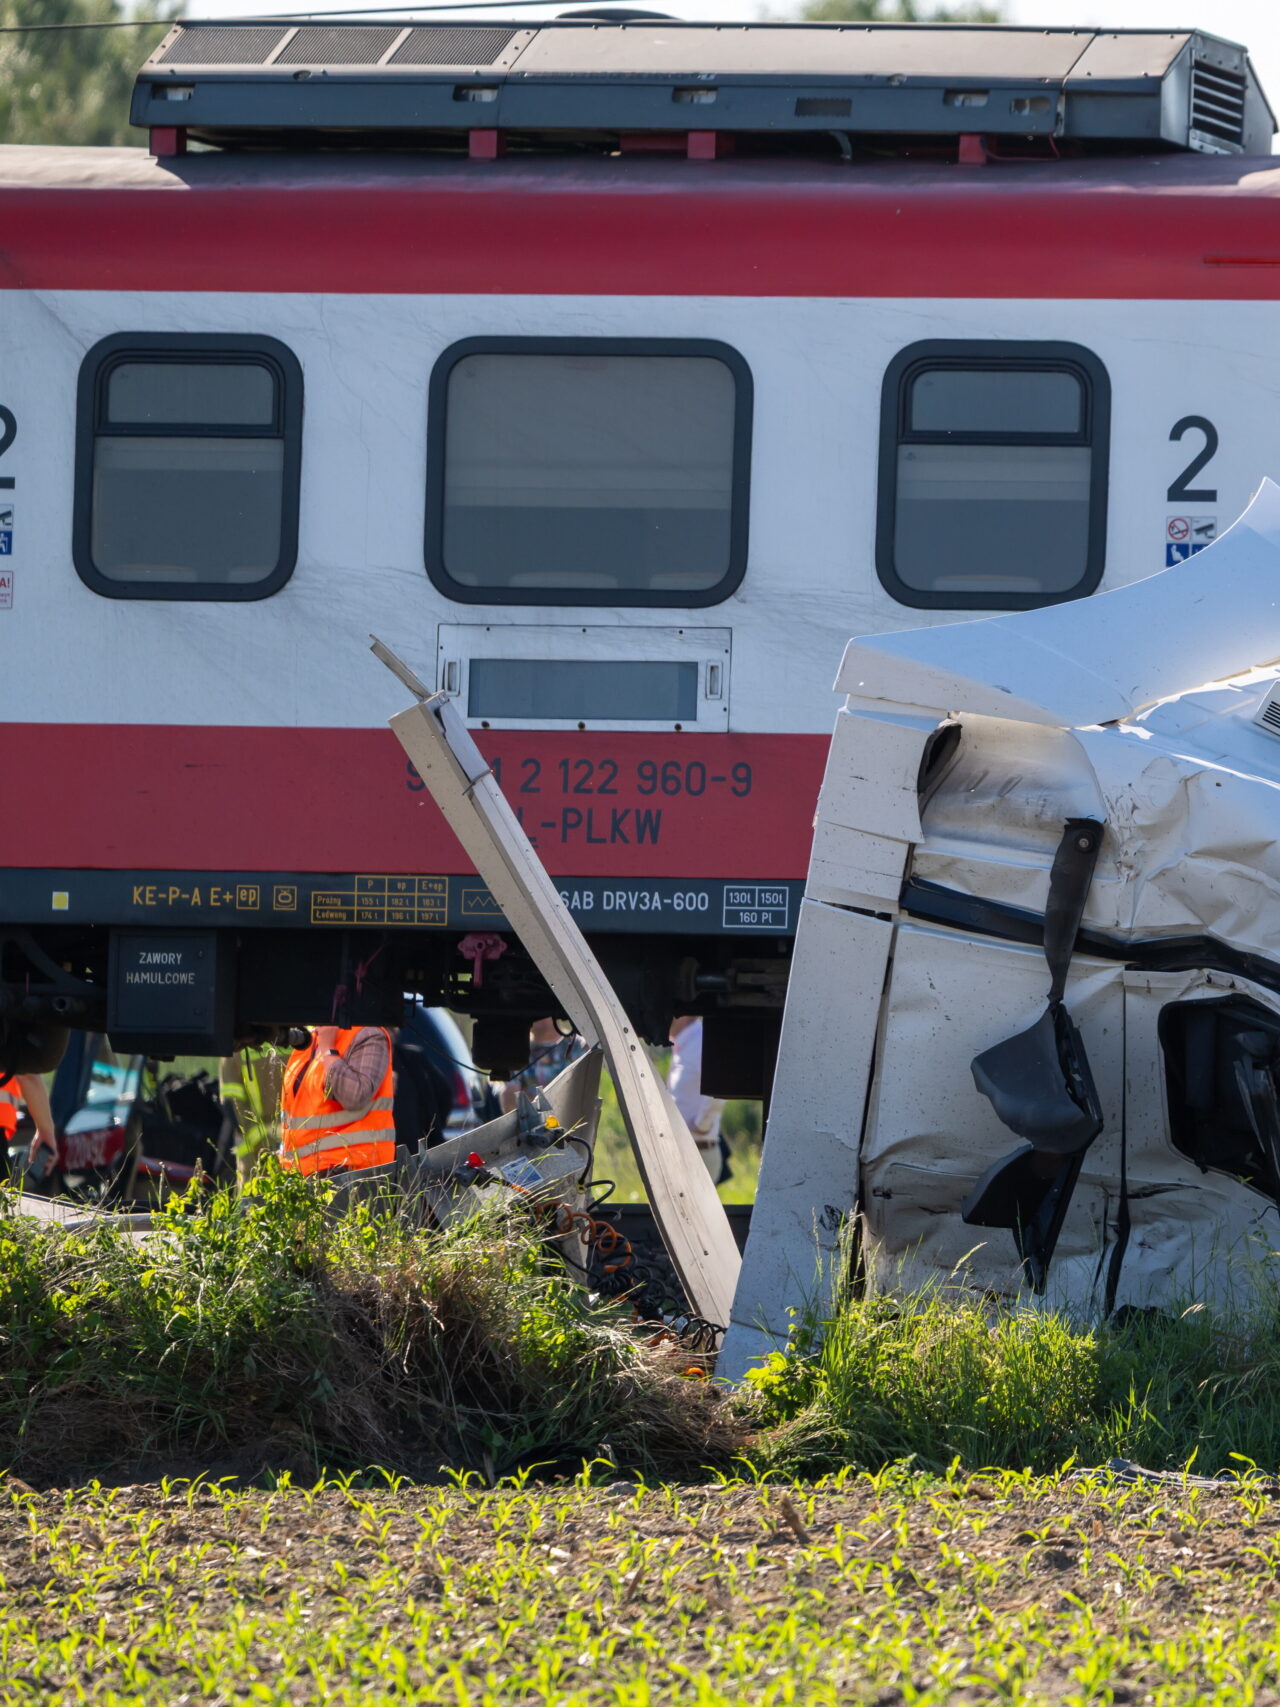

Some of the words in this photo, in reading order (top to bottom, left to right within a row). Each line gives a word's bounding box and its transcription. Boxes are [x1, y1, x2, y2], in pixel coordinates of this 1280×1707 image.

[1167, 415, 1219, 502] 2
[519, 757, 542, 793] 2
[558, 758, 619, 795] 122
[636, 760, 752, 798] 960-9
[133, 886, 202, 906] KE-P-A
[602, 891, 709, 911] DRV3A-600
[740, 911, 757, 923] 160
[139, 952, 182, 964] ZAWORY
[126, 972, 196, 984] HAMULCOWE
